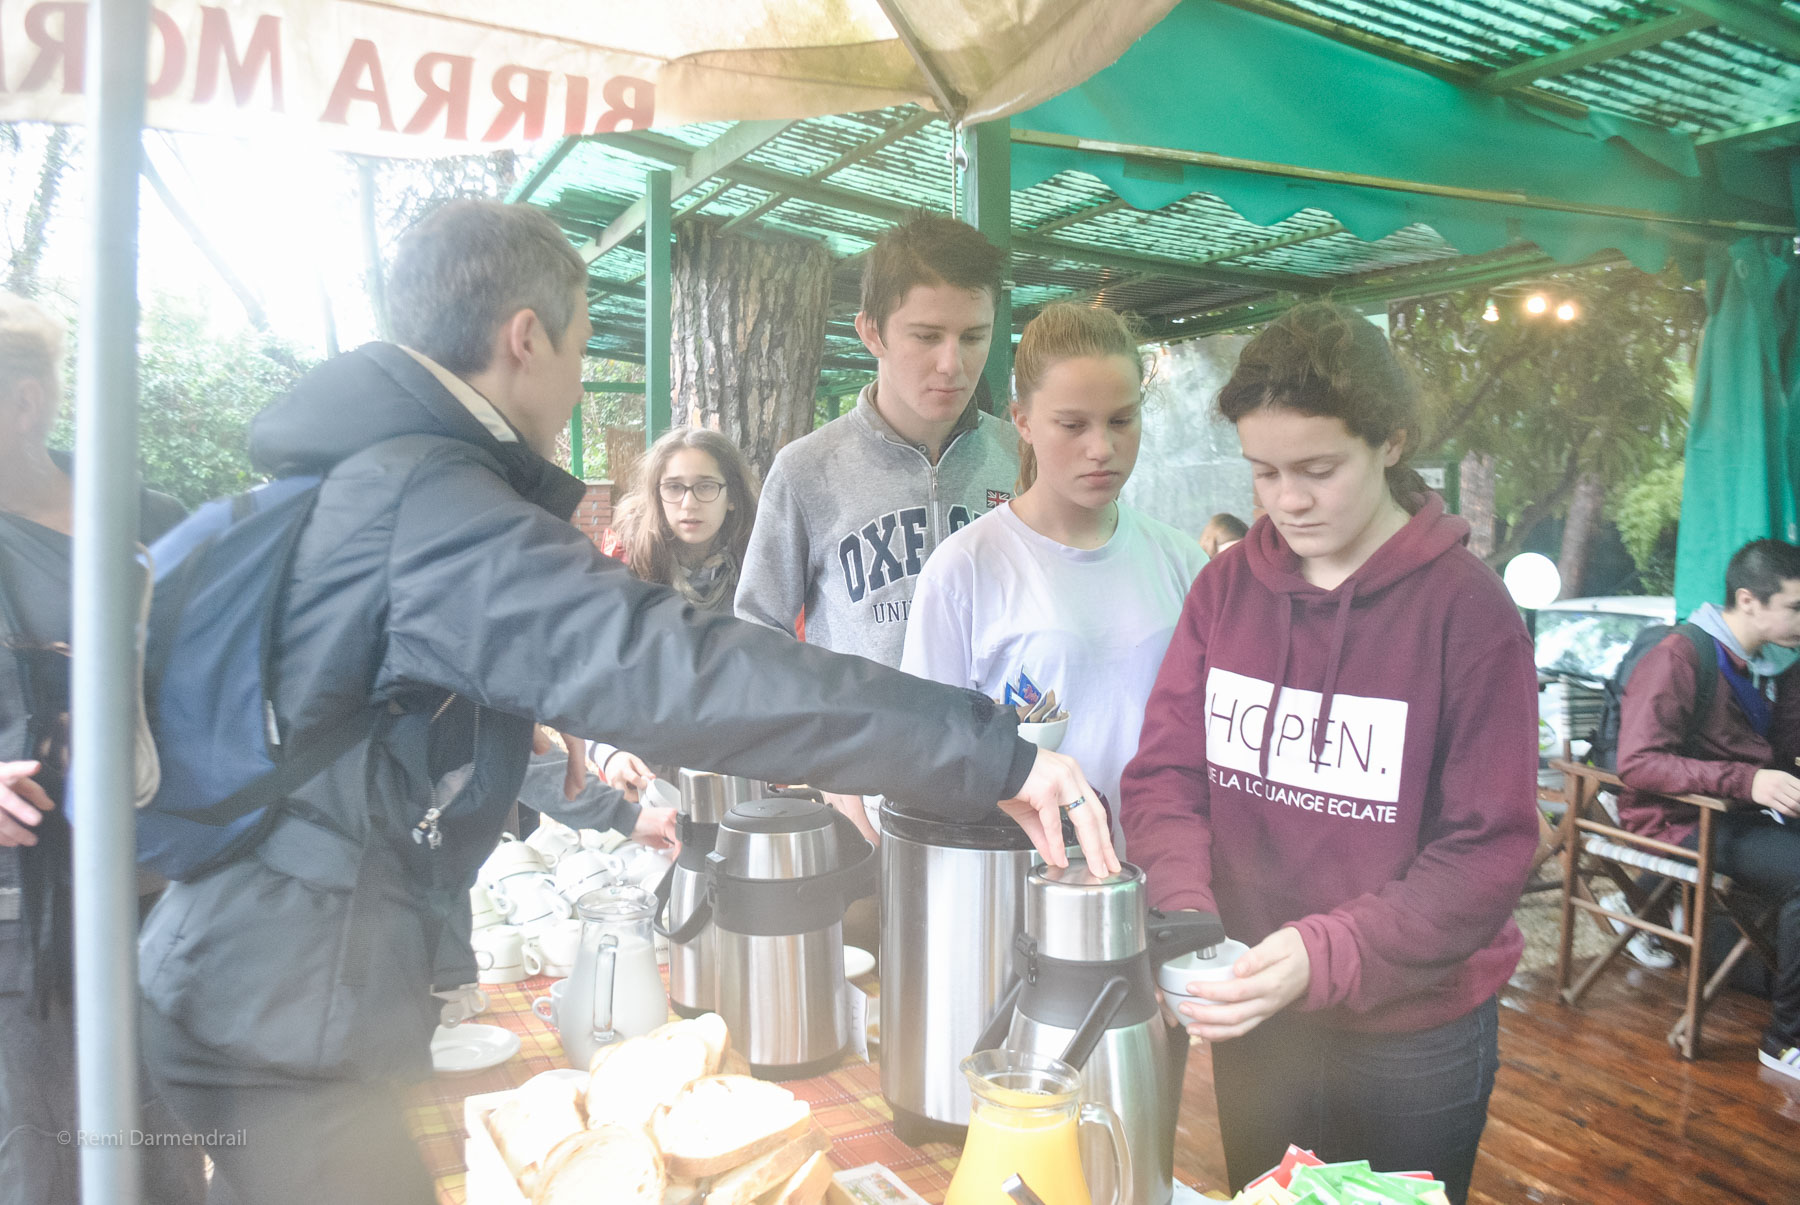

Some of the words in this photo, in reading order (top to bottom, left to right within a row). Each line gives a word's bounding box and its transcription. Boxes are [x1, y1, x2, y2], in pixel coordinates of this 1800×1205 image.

[838, 504, 983, 604] OXF
[872, 600, 912, 624] UNI
[1219, 771, 1241, 791] LA
[1327, 797, 1397, 823] ECLATE
